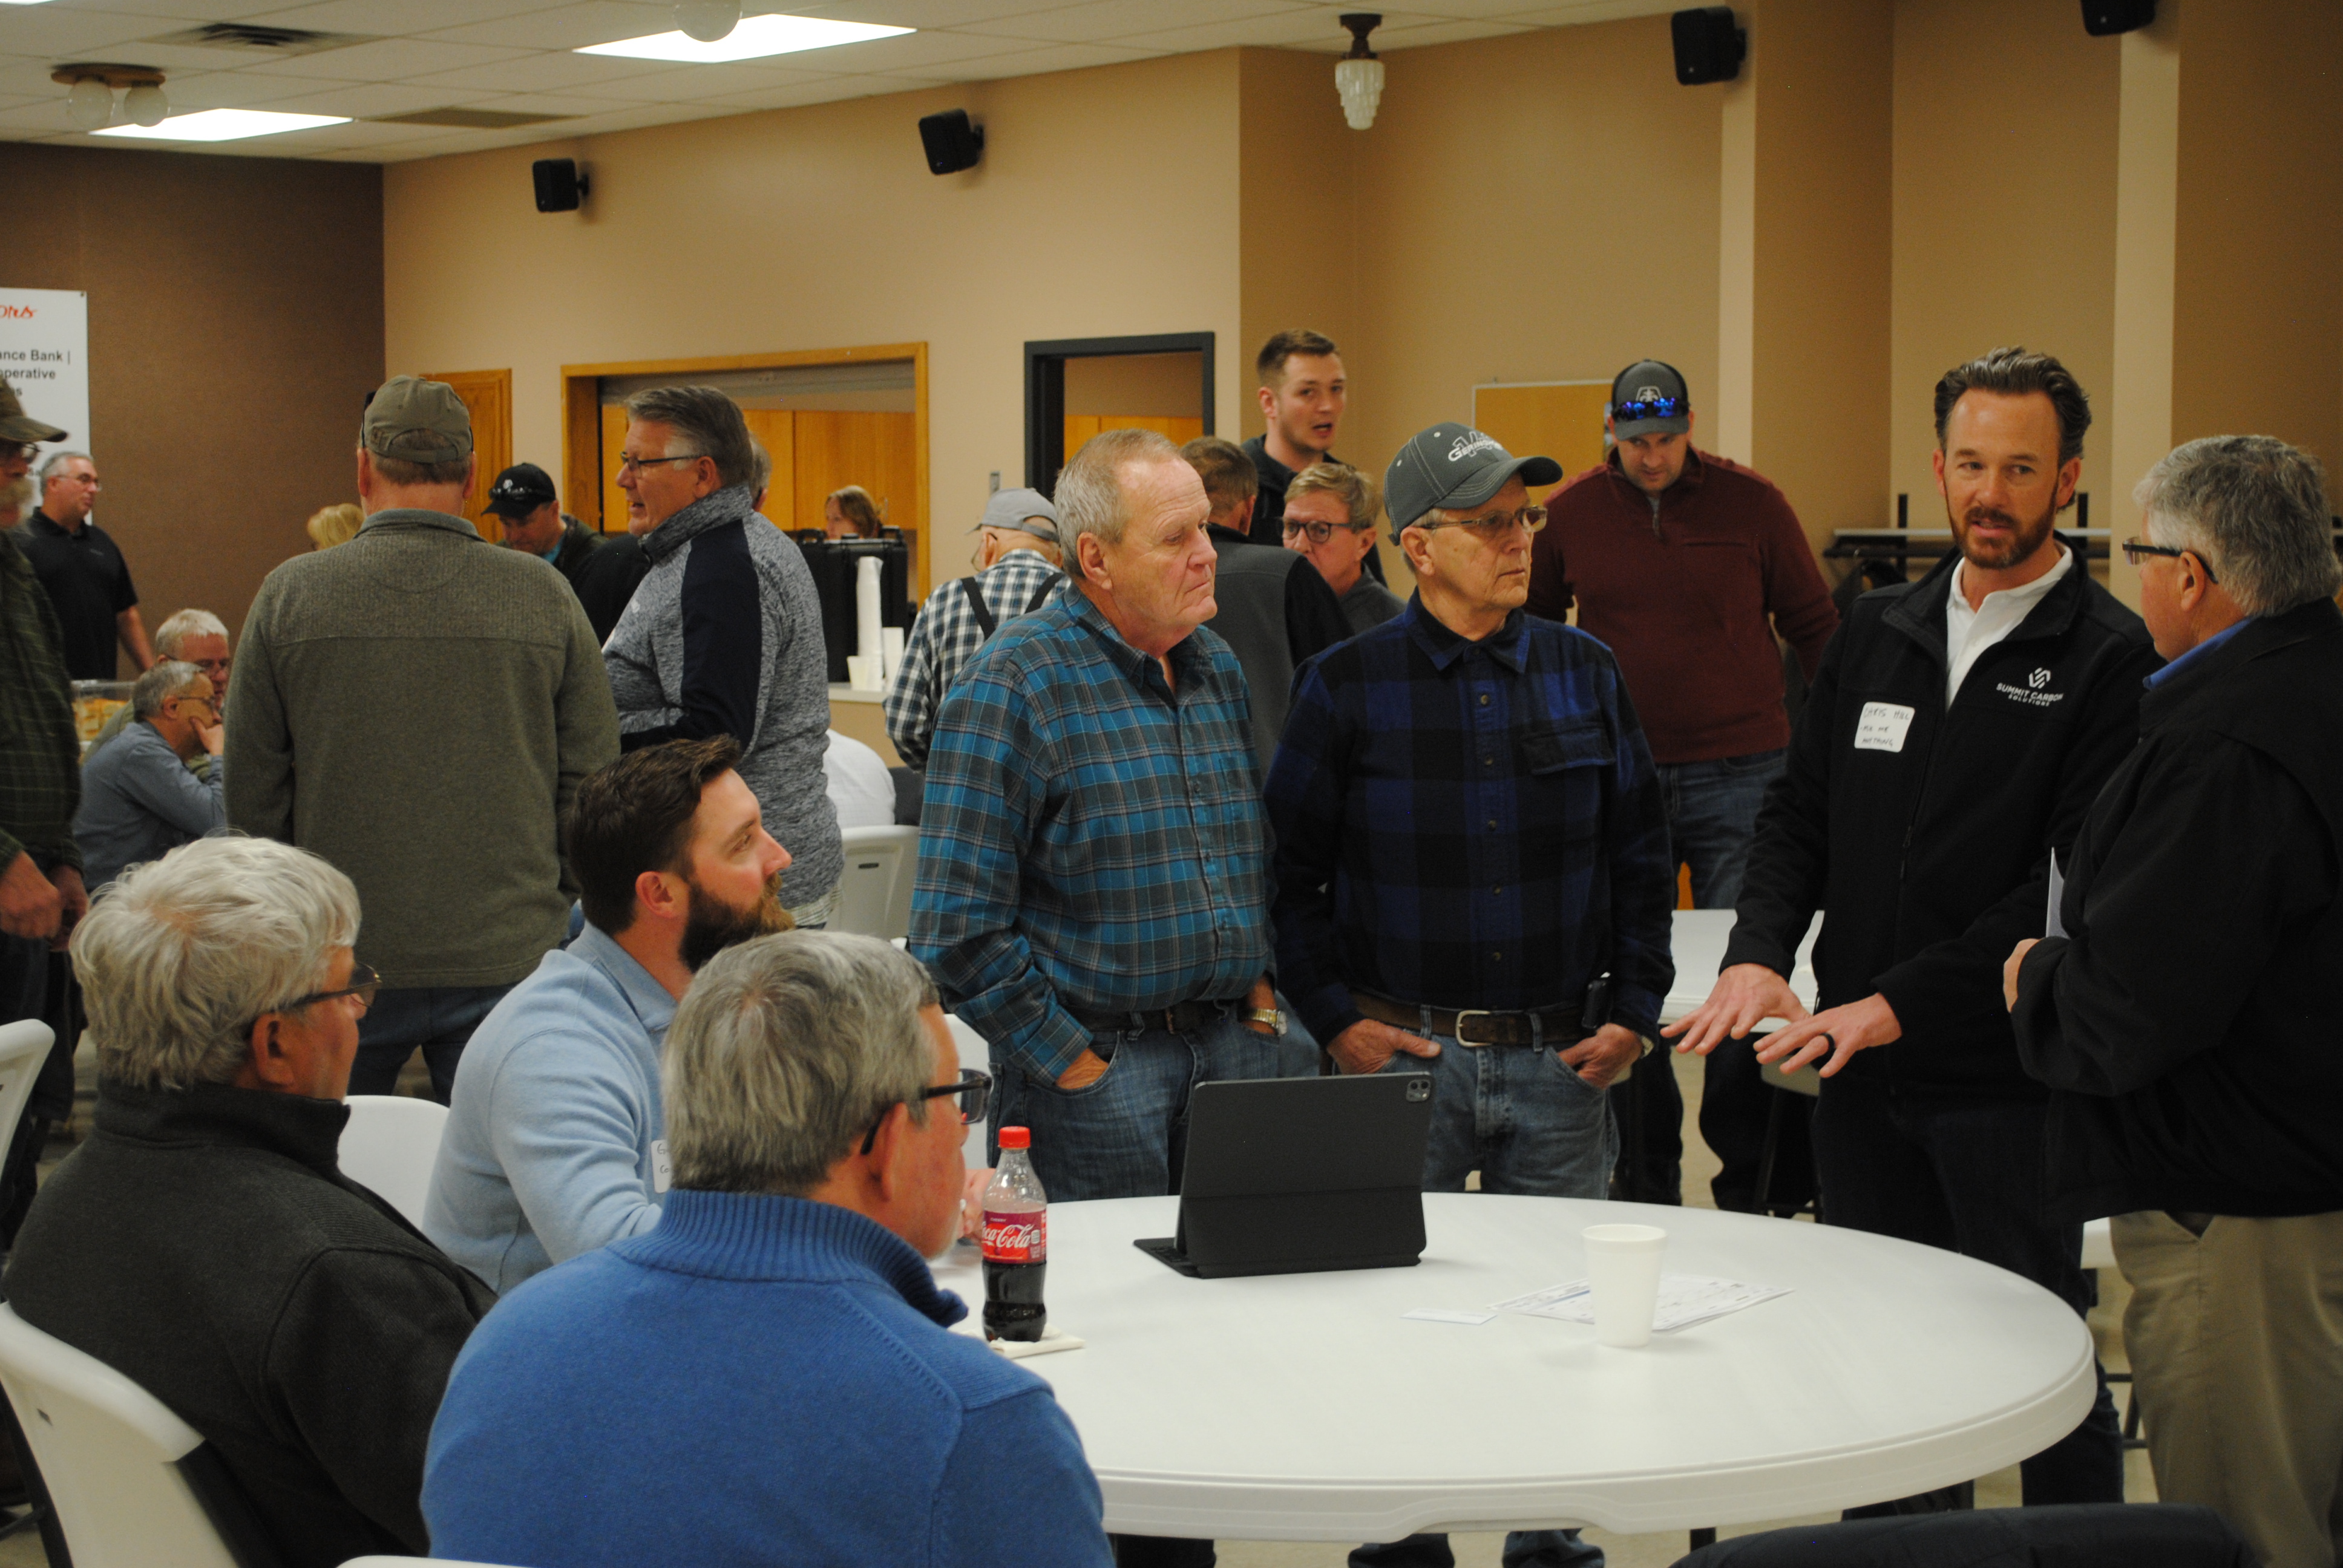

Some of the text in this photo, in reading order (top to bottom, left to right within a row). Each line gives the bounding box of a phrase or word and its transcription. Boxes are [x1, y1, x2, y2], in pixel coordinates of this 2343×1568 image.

[0, 351, 26, 361] nce
[31, 349, 63, 361] Bank
[1996, 682, 2030, 697] SUMMIT
